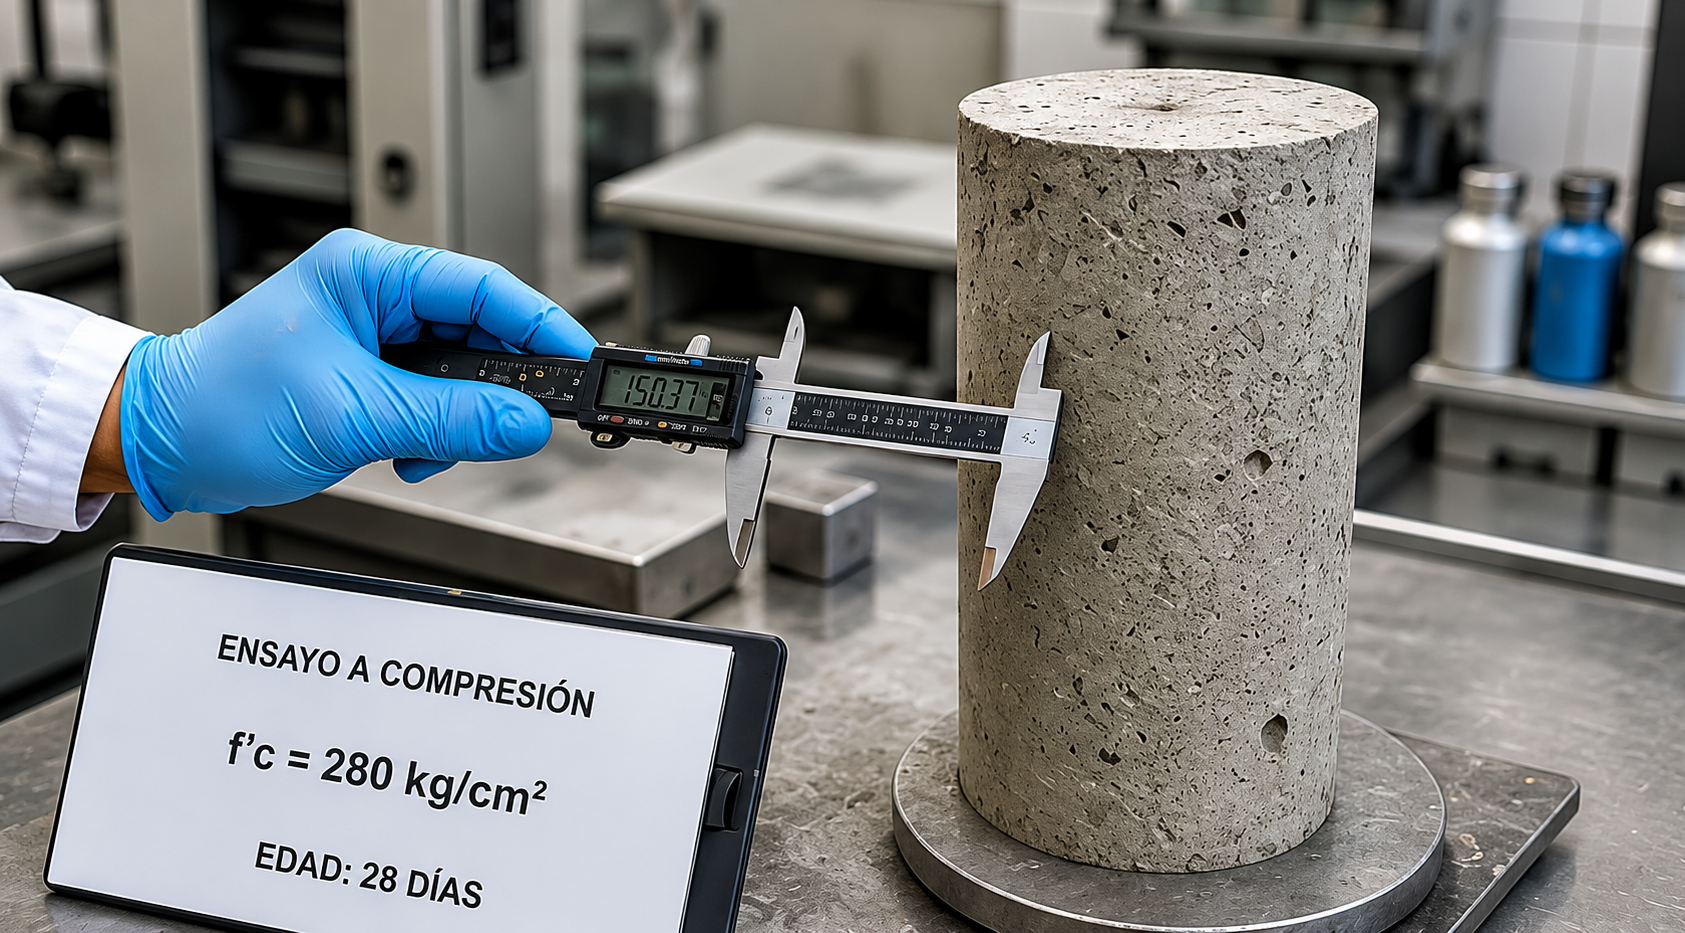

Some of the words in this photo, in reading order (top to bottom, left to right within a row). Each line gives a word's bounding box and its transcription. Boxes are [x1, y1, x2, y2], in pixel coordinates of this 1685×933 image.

[624, 375, 699, 412] 150.37
[218, 634, 341, 677] ENSAYO
[347, 655, 370, 683] A
[381, 660, 595, 718] COMPRESIÓN
[288, 750, 311, 770] =
[321, 748, 393, 791] 280
[405, 761, 548, 815] kg/cm²
[256, 842, 352, 885] EDAD:
[360, 863, 398, 893] 28
[407, 868, 483, 909] DÍAS
